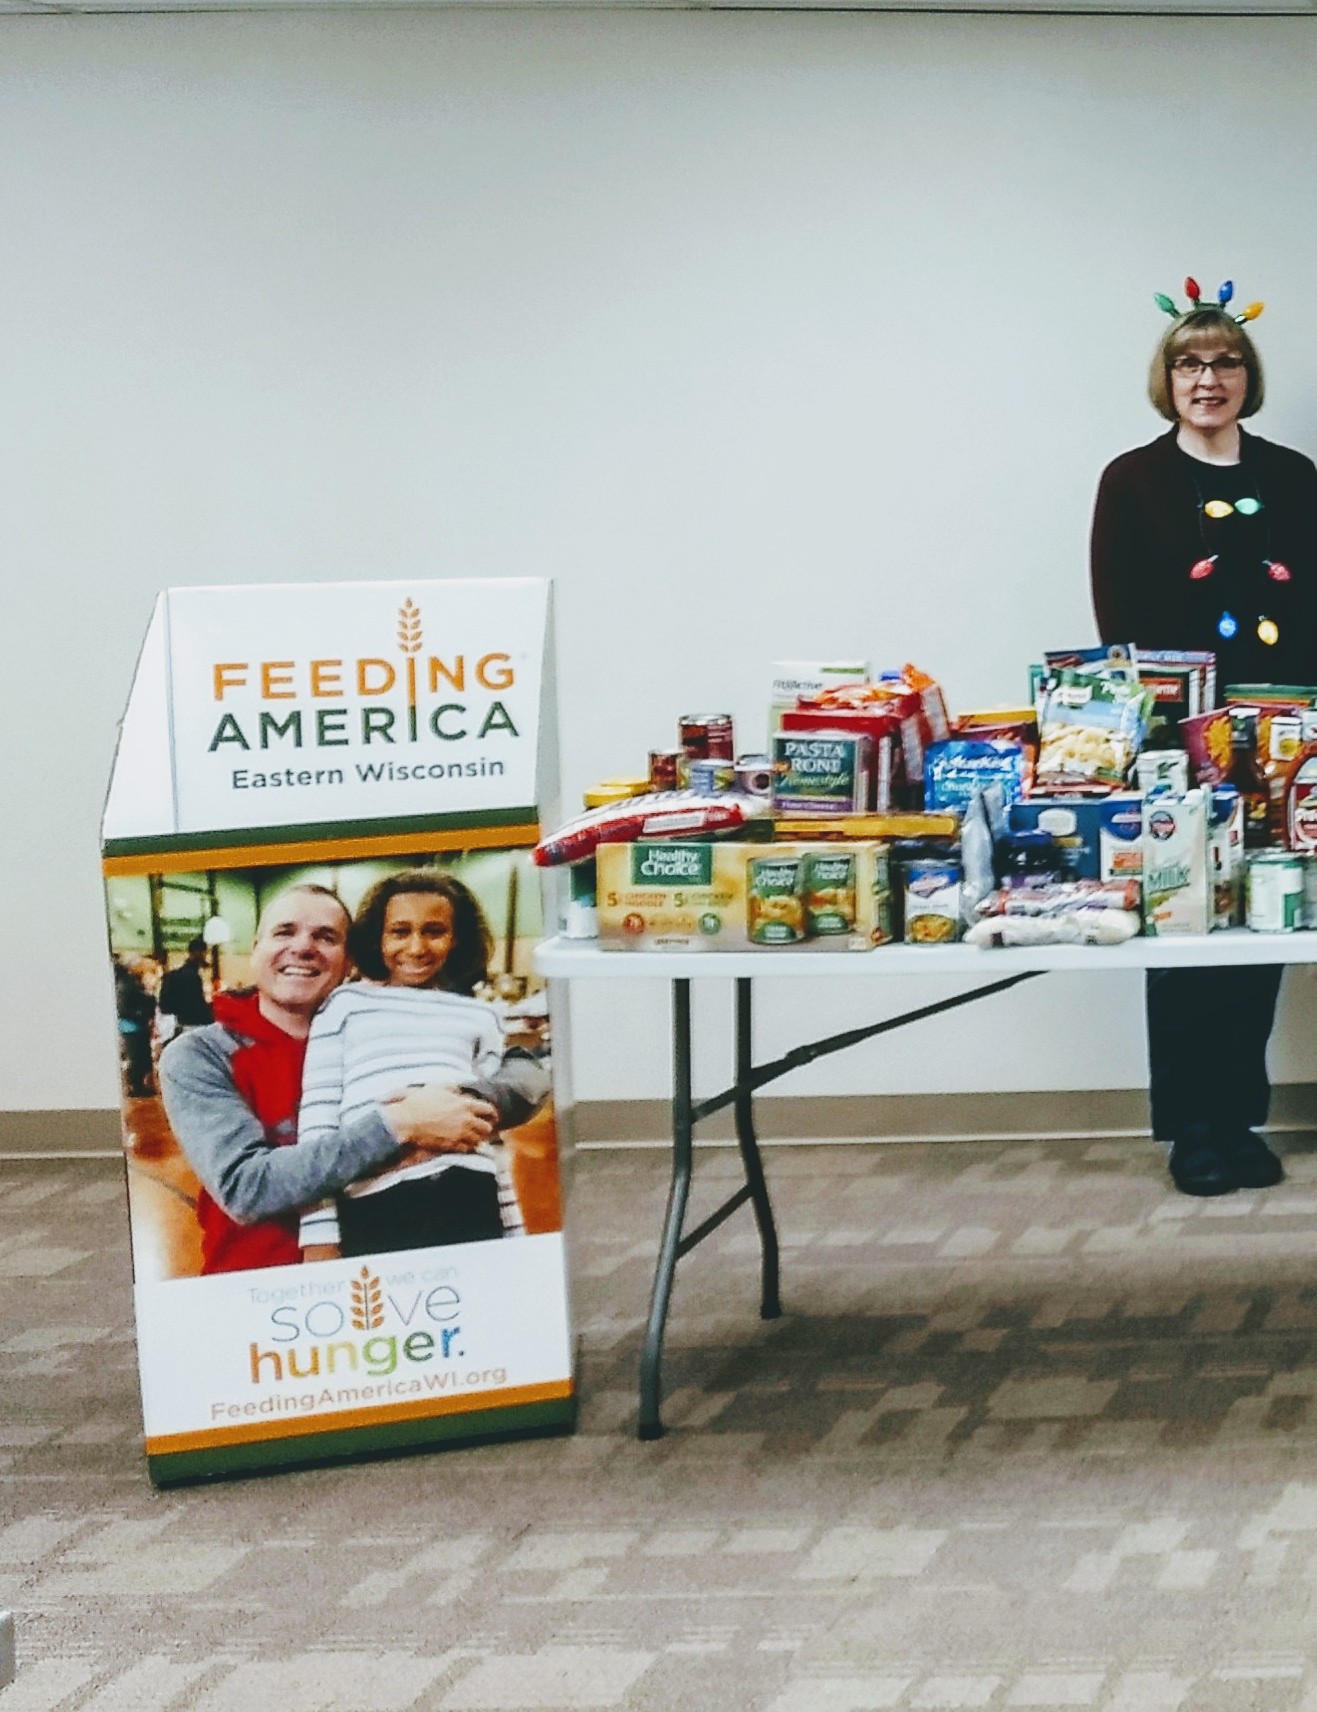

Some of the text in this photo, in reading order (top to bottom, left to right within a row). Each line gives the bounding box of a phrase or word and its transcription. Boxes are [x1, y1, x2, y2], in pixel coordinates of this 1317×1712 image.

[213, 652, 515, 703] FEEDING
[207, 701, 520, 752] AMERICA
[785, 742, 846, 759] PASTA
[232, 758, 505, 790] Eastern Wisconsin
[641, 860, 700, 876] Choice
[648, 850, 698, 864] Healthy
[249, 1265, 459, 1305] Together we can
[249, 1325, 466, 1385] hunger.
[211, 1364, 508, 1421] FeedingAmericaWI.org
